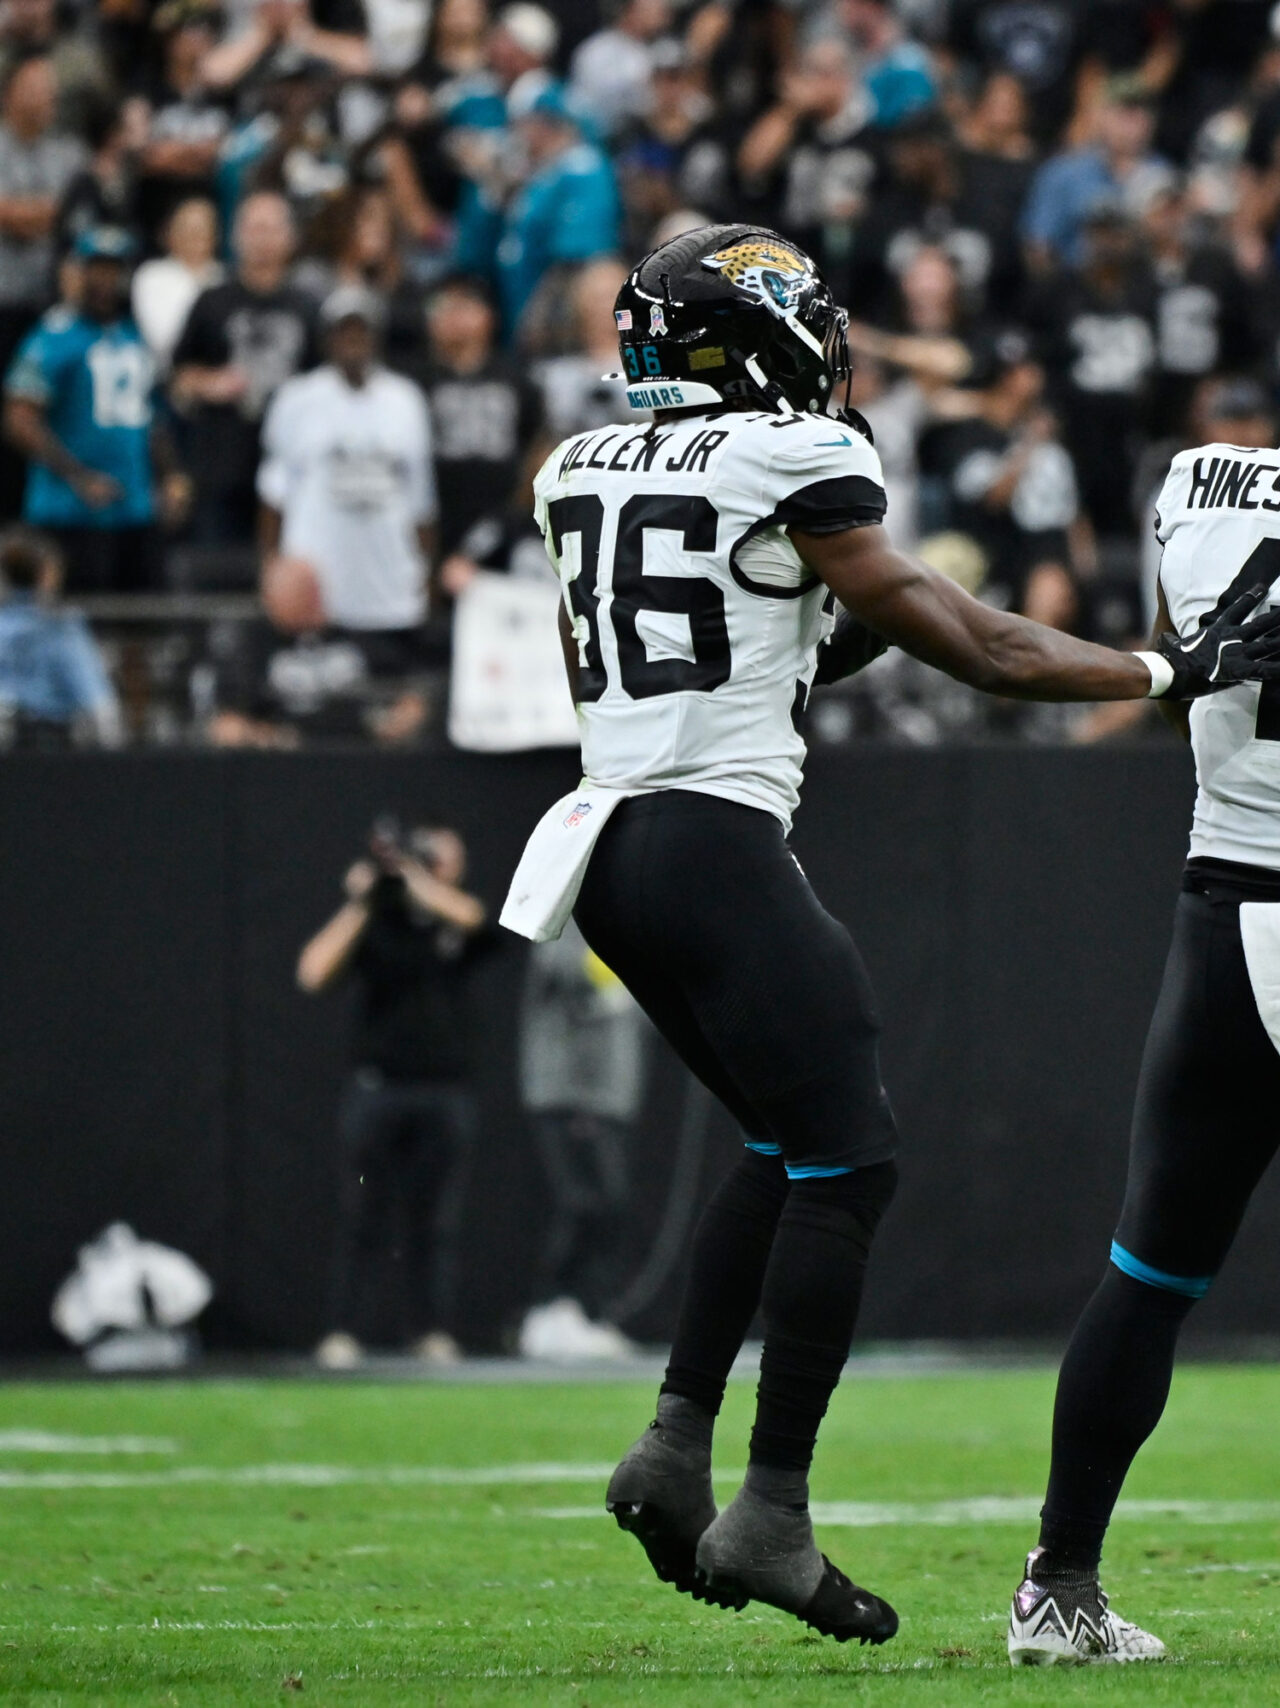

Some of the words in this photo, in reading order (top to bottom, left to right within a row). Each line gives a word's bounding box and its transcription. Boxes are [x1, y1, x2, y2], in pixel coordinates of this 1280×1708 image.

[624, 345, 662, 377] 36
[558, 433, 675, 482] ALLEN
[665, 429, 730, 473] JR
[547, 494, 732, 703] 36
